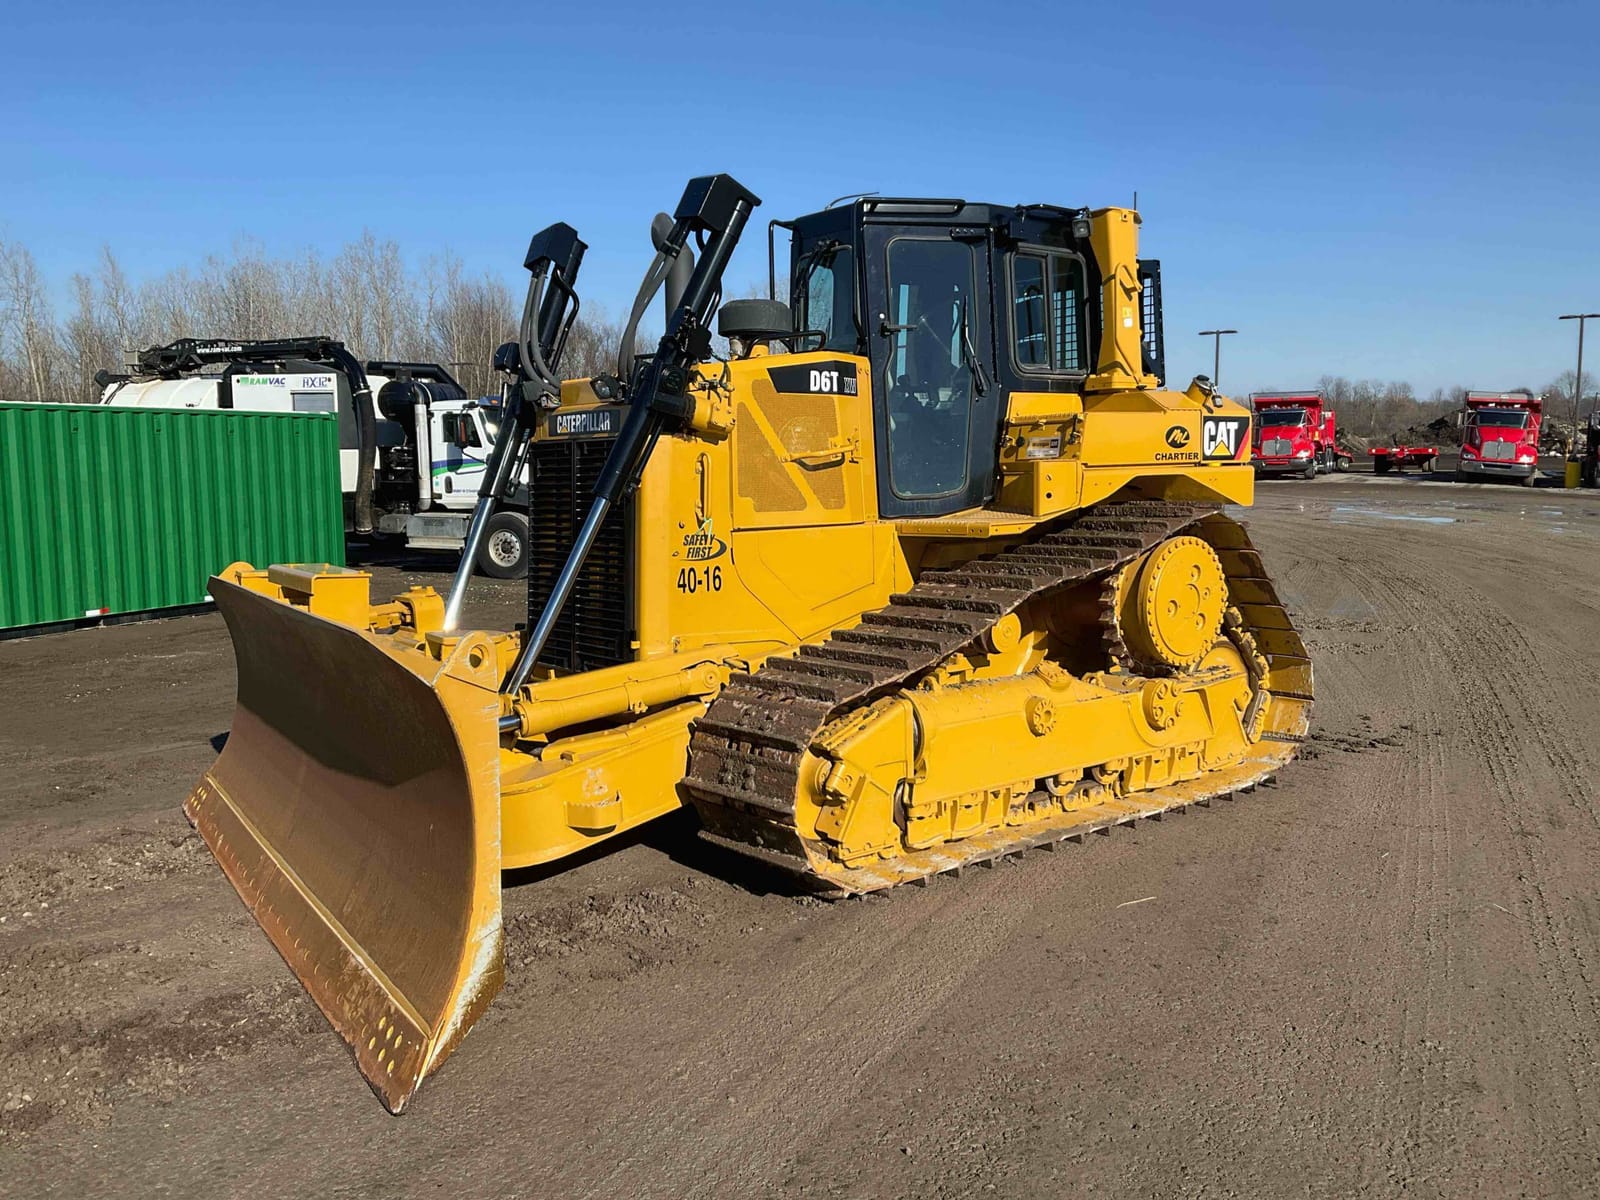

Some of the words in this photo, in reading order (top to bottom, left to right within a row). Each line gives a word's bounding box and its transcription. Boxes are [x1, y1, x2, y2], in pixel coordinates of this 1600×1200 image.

[249, 377, 286, 385] RAMVAC
[810, 370, 839, 392] D6T
[556, 411, 610, 434] CATERPILLAR
[1203, 420, 1239, 456] CAT
[1154, 452, 1199, 461] CHARTIER
[683, 534, 715, 546] SAFETY
[686, 546, 712, 559] FIRST
[677, 565, 722, 594] 40-16
